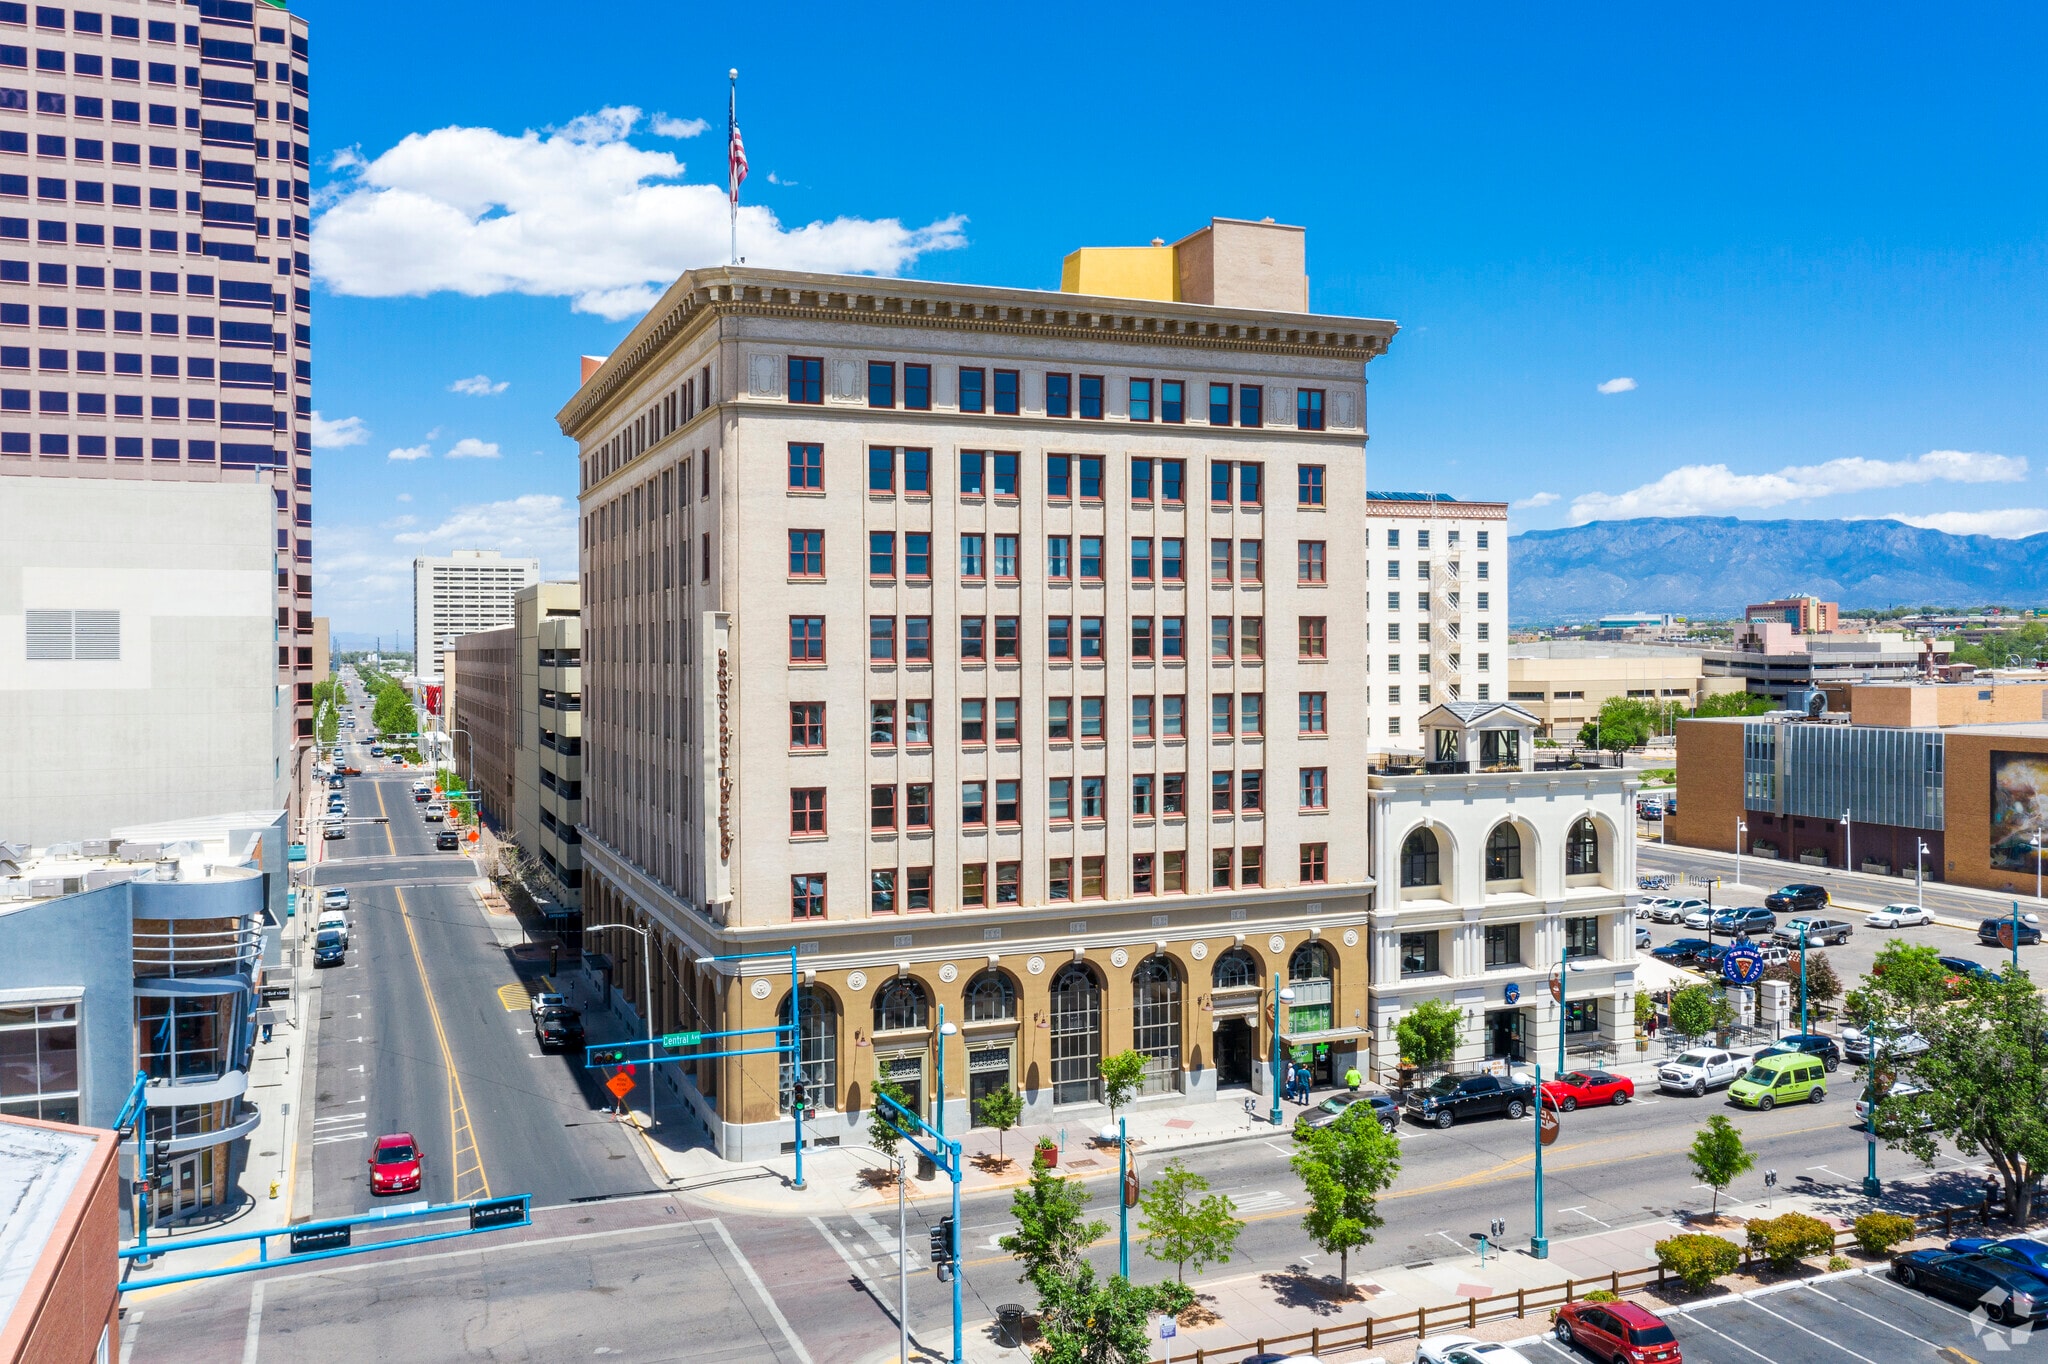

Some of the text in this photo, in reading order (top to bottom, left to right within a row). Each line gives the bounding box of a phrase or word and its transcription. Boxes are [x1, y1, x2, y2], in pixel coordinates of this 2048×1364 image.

[1727, 961, 1736, 978] PIZZA
[663, 1035, 689, 1045] Central
[1291, 1050, 1308, 1058] SWOP
